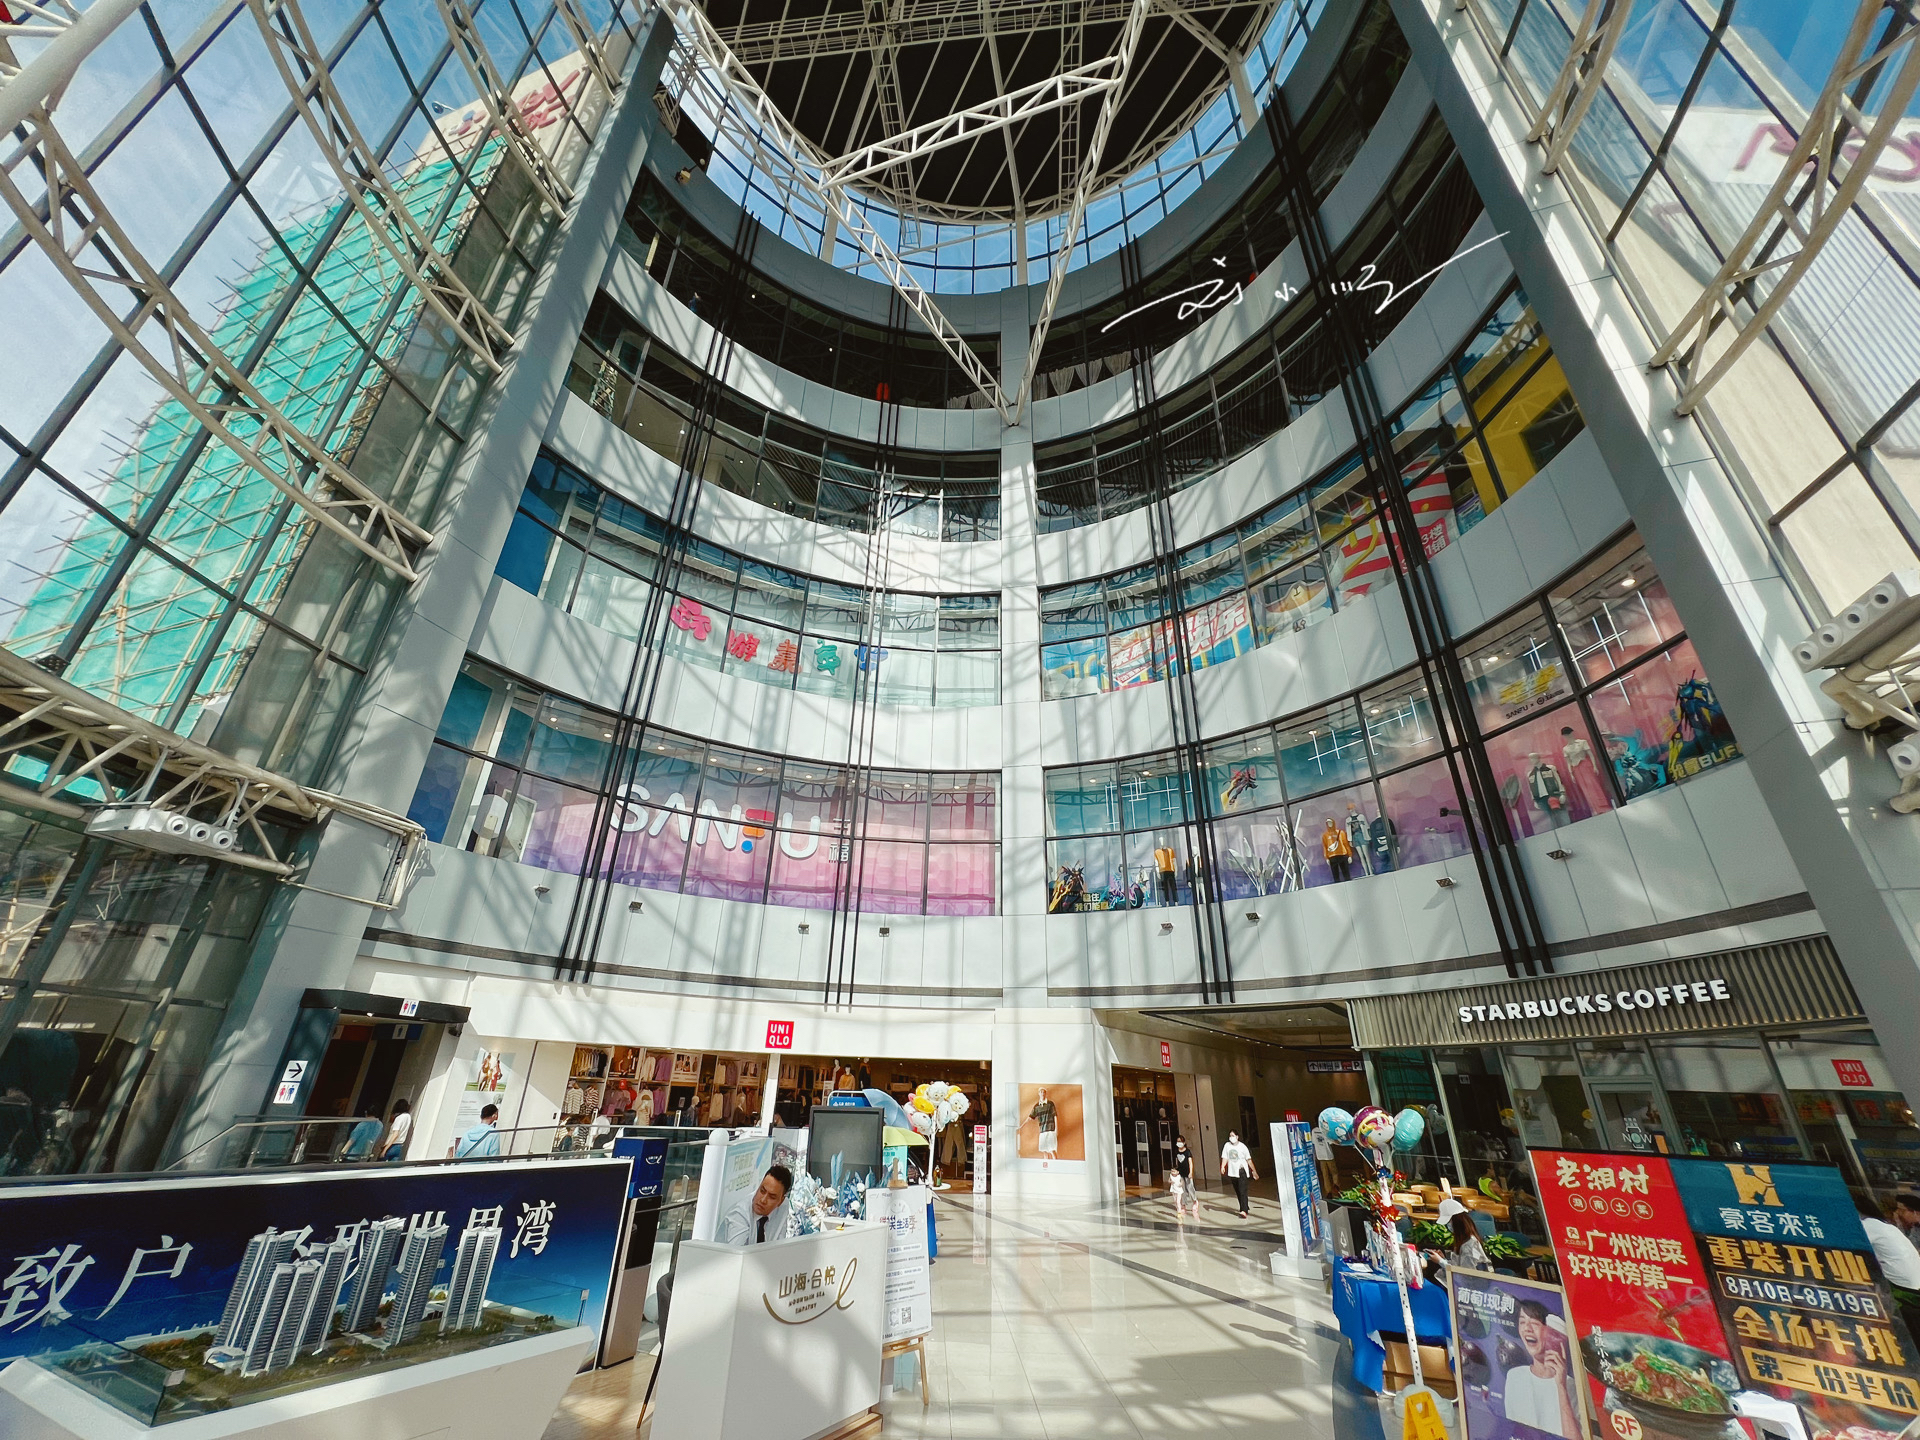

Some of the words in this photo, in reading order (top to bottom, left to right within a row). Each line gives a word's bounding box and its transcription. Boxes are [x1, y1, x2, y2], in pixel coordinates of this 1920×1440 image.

[1458, 993, 1612, 1023] STARBUCKS
[1616, 979, 1731, 1011] COFFEE
[768, 1035, 791, 1046] QLO
[770, 1023, 790, 1035] UNI
[1556, 1157, 1650, 1195] 老湘村
[1569, 1195, 1652, 1218] 湖南土菜
[1805, 1214, 1825, 1239] 牛排
[1586, 1229, 1689, 1266] 广州湘菜
[1705, 1235, 1875, 1287] 重装开业
[778, 1265, 836, 1299] 山海·合悦
[1567, 1252, 1694, 1290] 好评榜第一
[788, 1293, 815, 1307] MOUNTAIN
[795, 1302, 817, 1314] EMPATHY
[1725, 1275, 1880, 1318] 8月10日-8月19日
[1733, 1305, 1906, 1366] 全场牛排
[1751, 1352, 1920, 1411] 第二份半价
[1613, 1414, 1639, 1437] 5F
